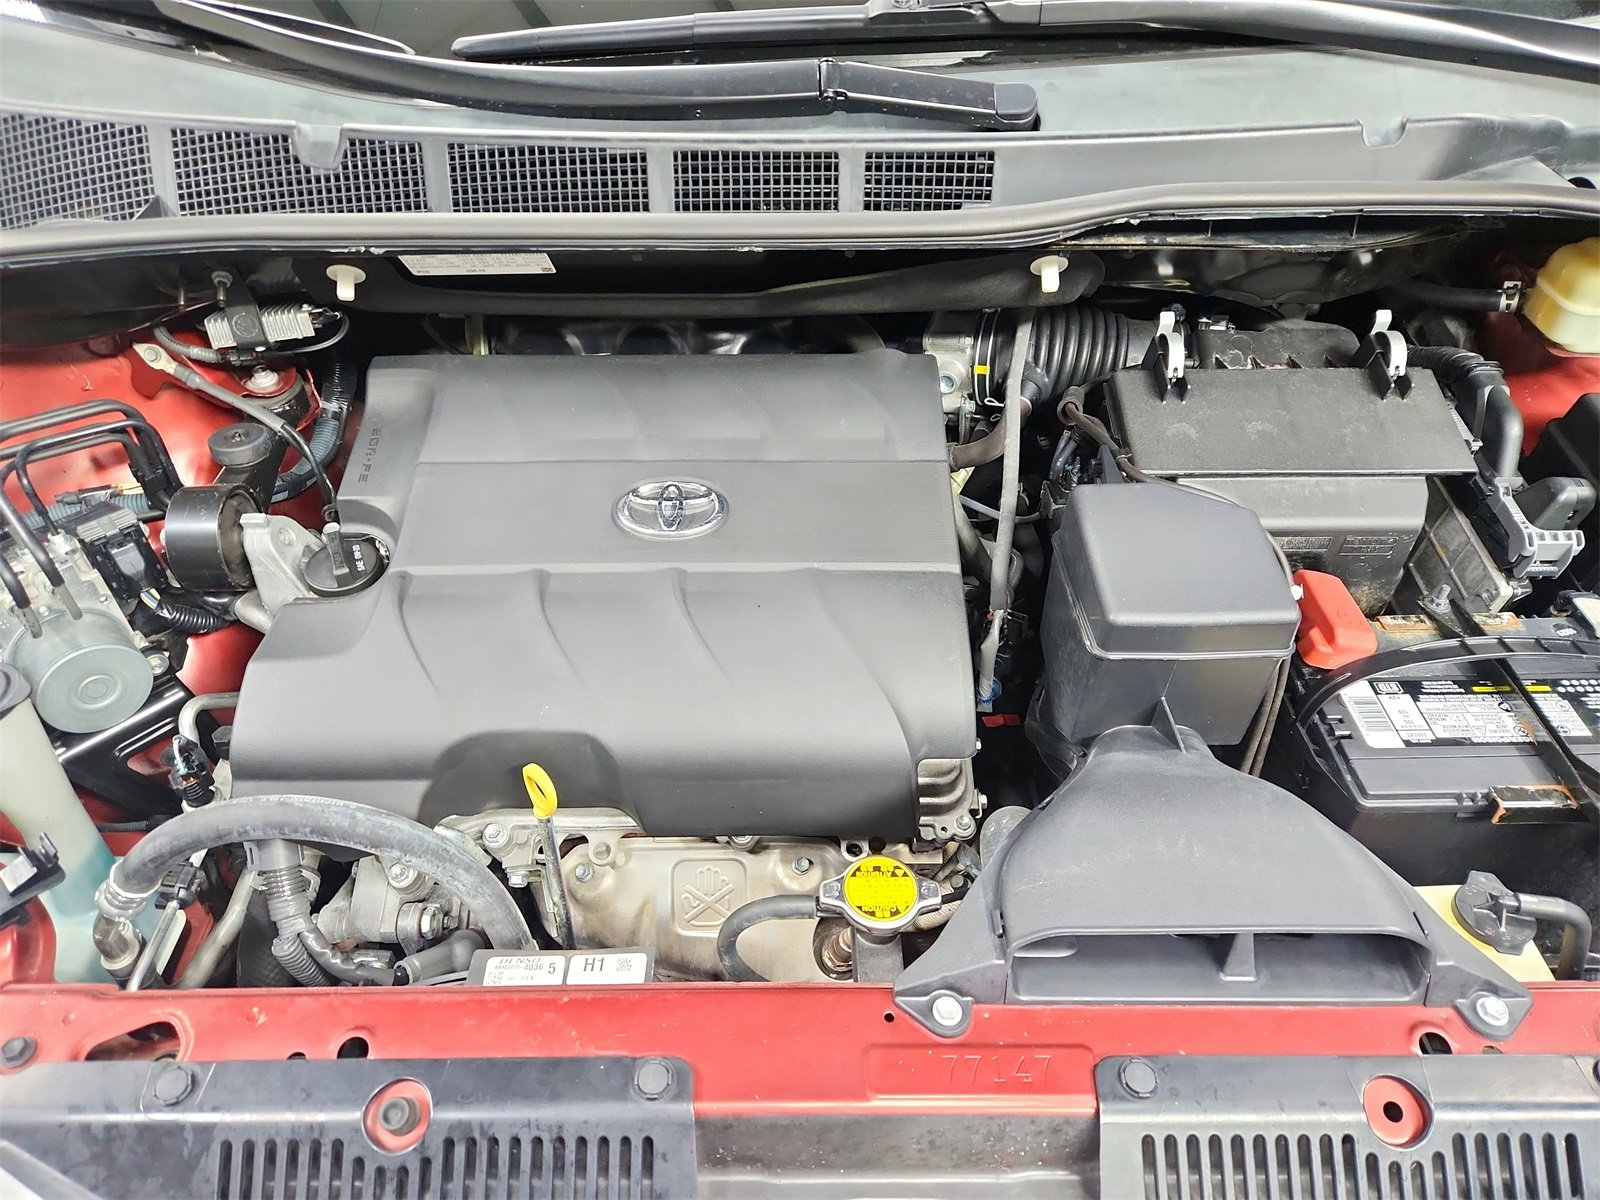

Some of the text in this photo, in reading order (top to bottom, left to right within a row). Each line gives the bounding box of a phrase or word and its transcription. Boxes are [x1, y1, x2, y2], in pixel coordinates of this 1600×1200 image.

[548, 962, 557, 974] 5
[583, 956, 606, 972] H1
[941, 1054, 1052, 1083] 77147
